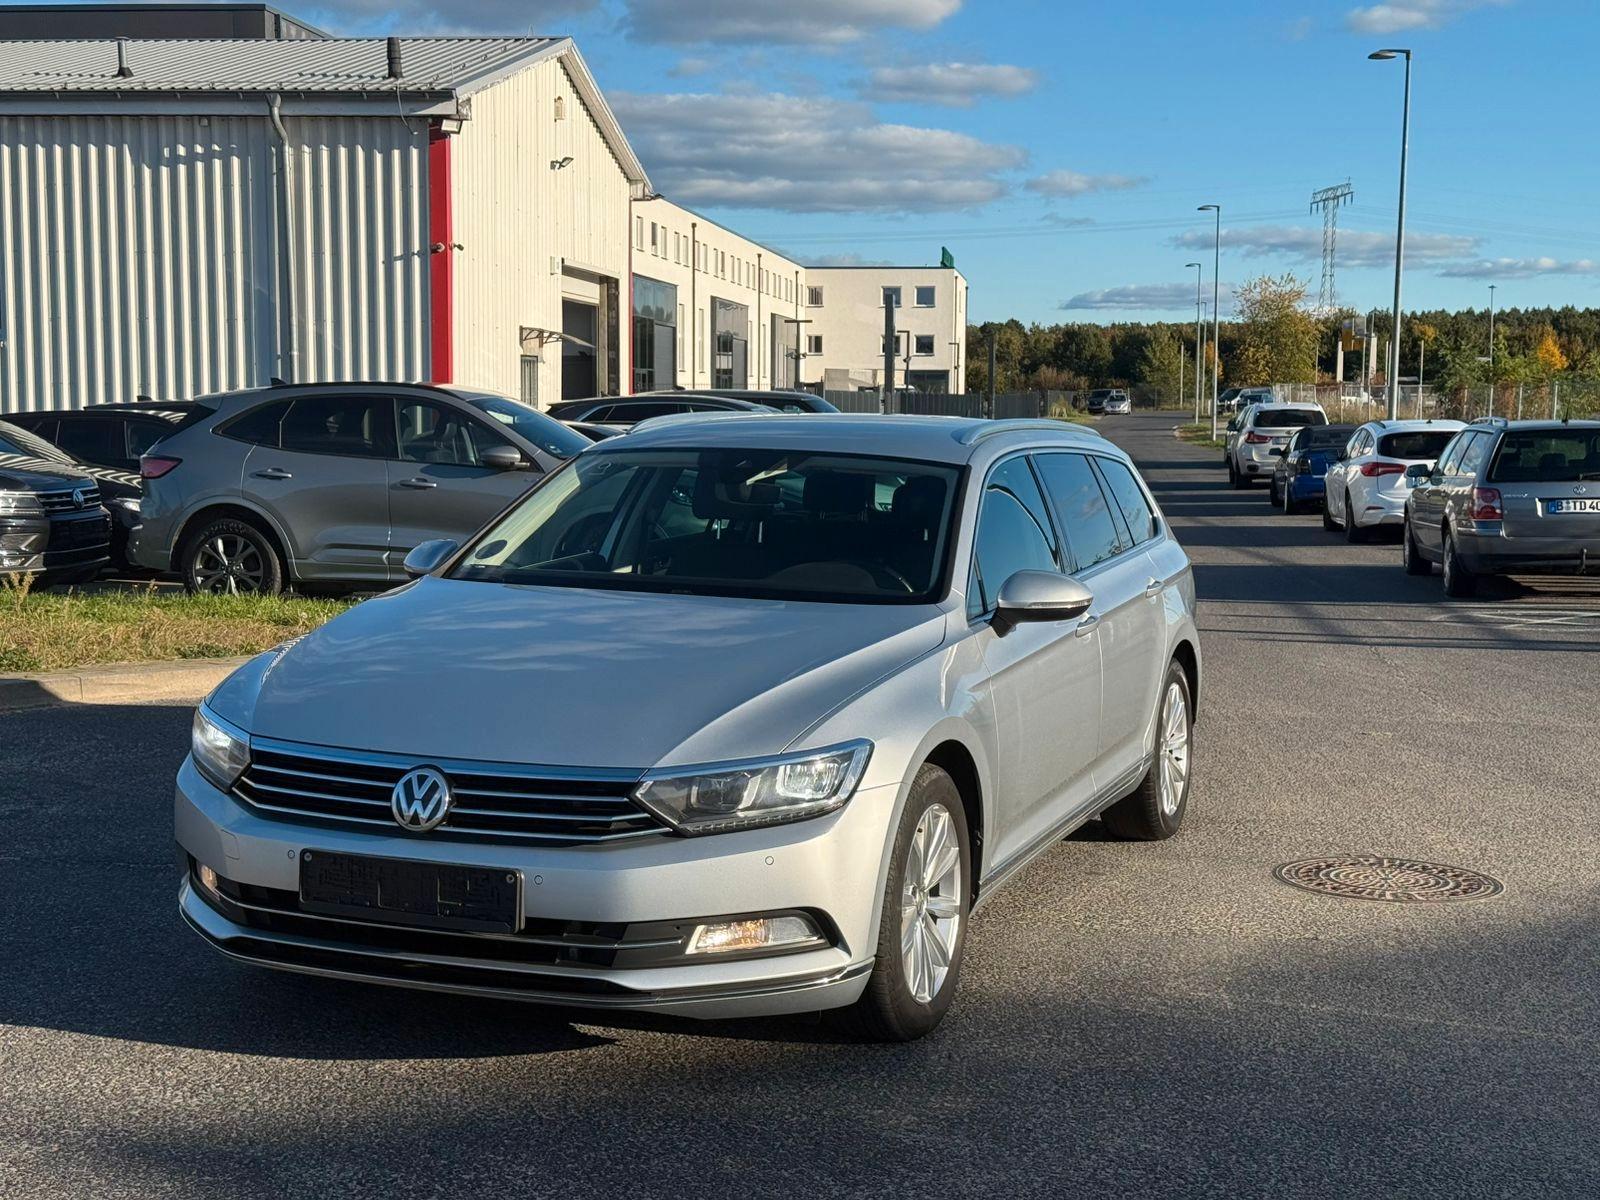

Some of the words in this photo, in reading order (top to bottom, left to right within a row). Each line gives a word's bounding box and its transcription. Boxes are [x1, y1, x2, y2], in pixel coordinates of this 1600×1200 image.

[1556, 501, 1564, 511] B
[1572, 501, 1587, 511] TD
[392, 768, 449, 831] VW
